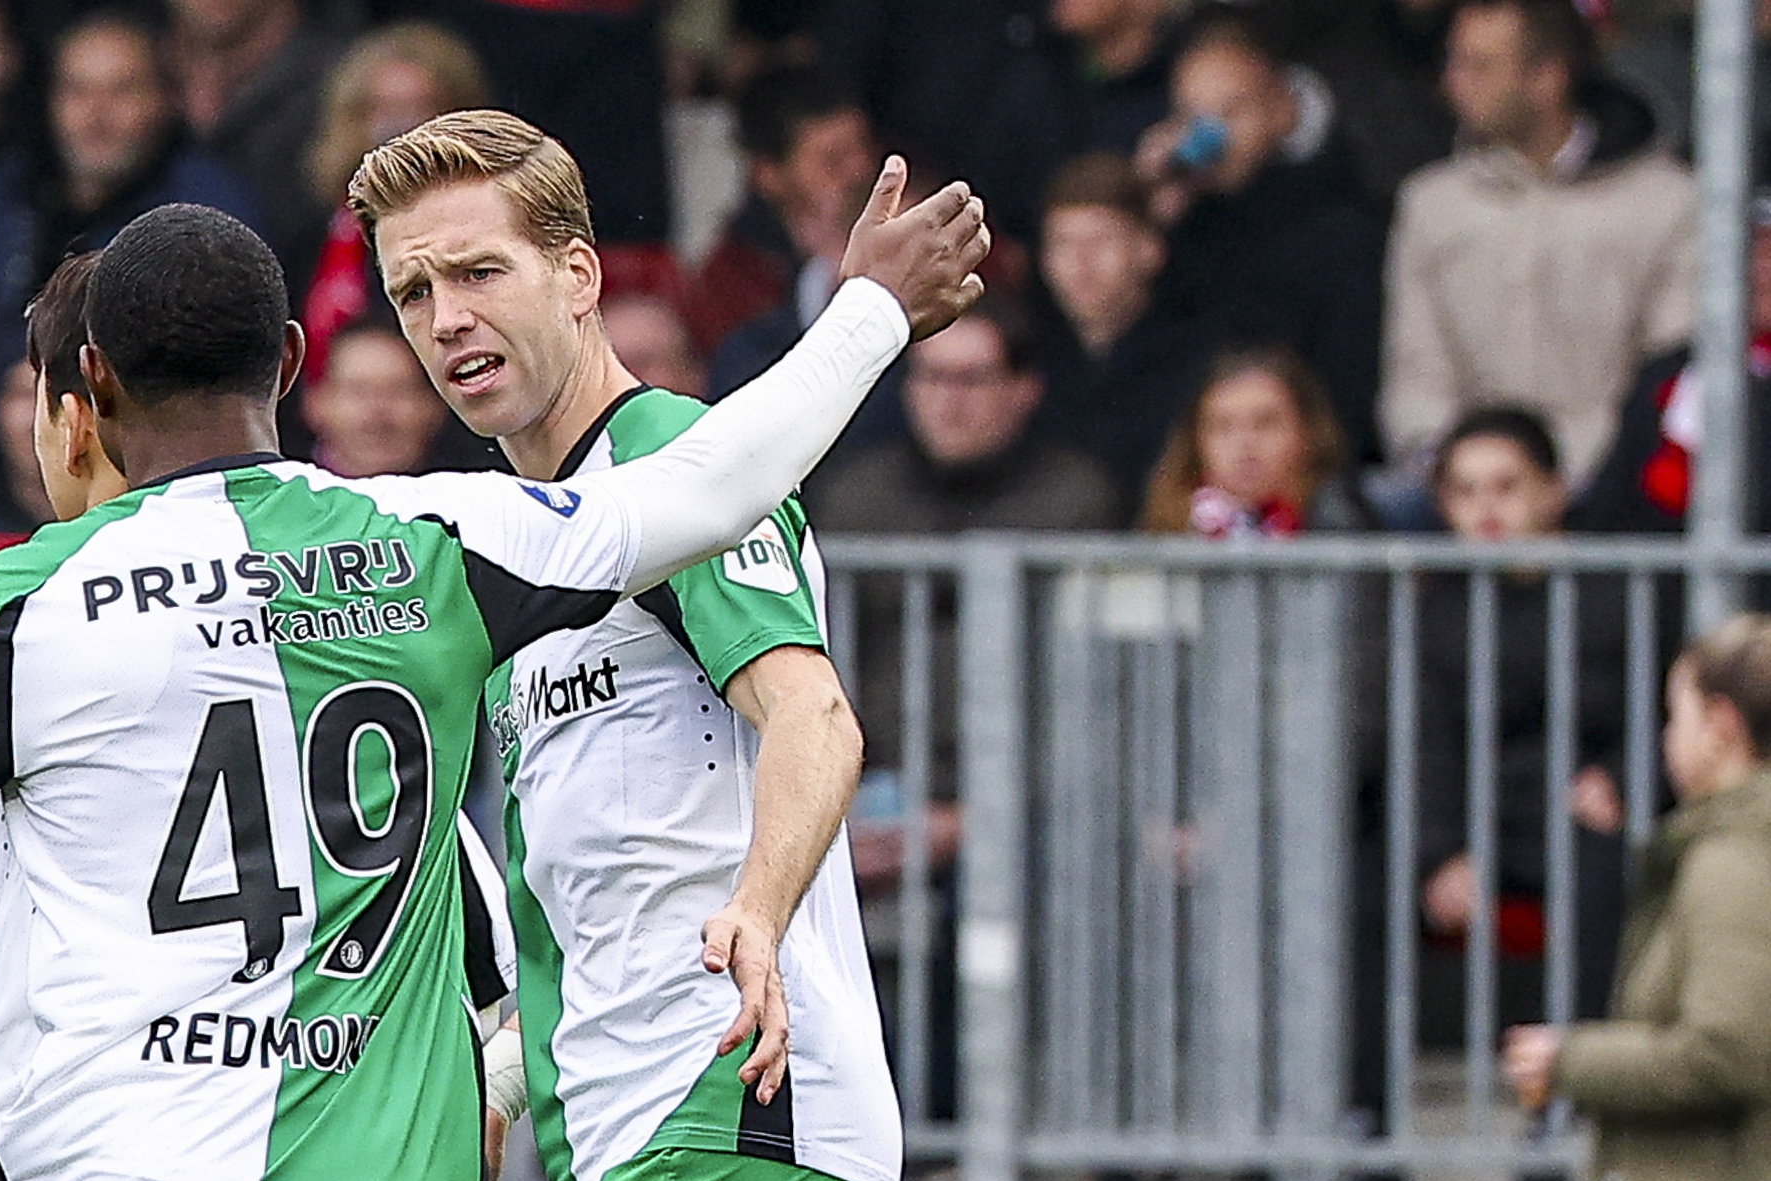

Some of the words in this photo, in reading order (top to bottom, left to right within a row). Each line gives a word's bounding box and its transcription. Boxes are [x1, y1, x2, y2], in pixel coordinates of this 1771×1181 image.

[196, 595, 430, 649] vakanties
[524, 656, 620, 730] Markt
[146, 681, 434, 984] 49
